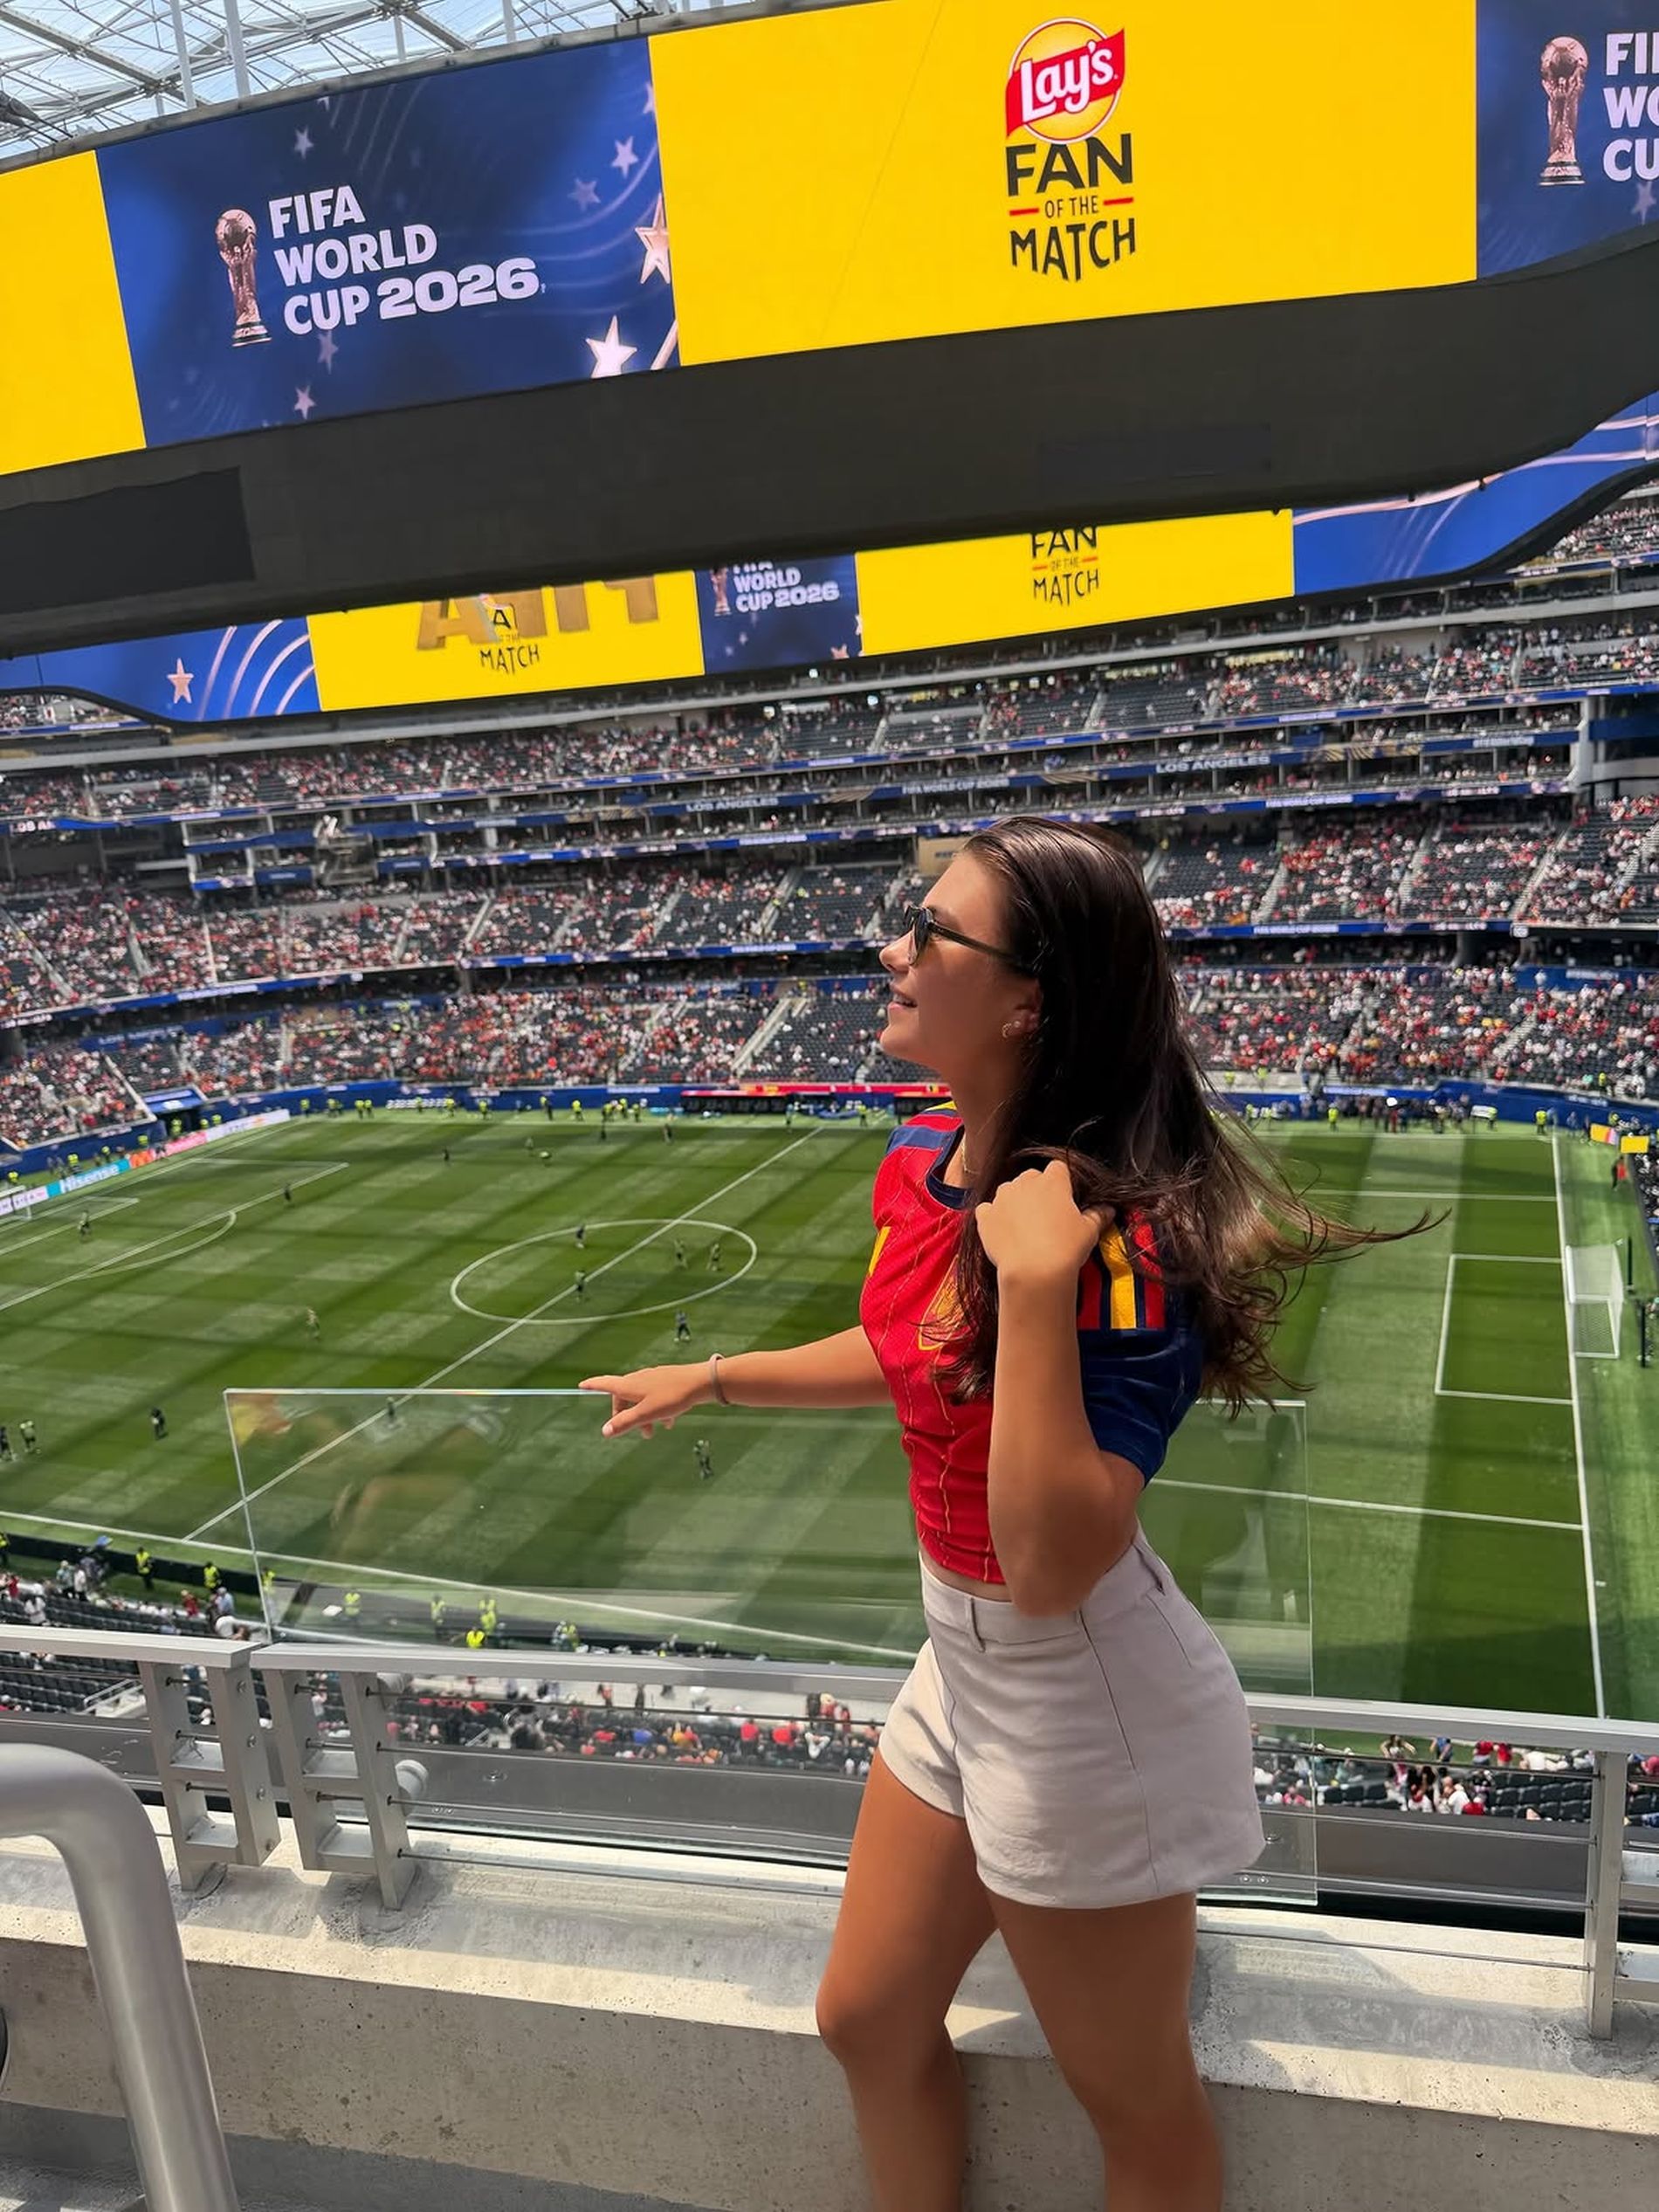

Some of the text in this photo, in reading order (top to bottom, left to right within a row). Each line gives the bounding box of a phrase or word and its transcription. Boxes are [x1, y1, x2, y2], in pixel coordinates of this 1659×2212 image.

[1020, 39, 1114, 122] Lay's
[1005, 133, 1133, 196] FAN
[268, 185, 366, 238] FIFA
[1044, 195, 1098, 218] OF THE
[273, 224, 437, 286] WORLD
[1009, 217, 1136, 282] MATCH
[284, 258, 540, 335] CUP 2026
[733, 567, 802, 594] WORLD
[736, 580, 840, 612] CUP 2026
[1034, 568, 1099, 606] MATCH
[479, 644, 540, 675] MATCH
